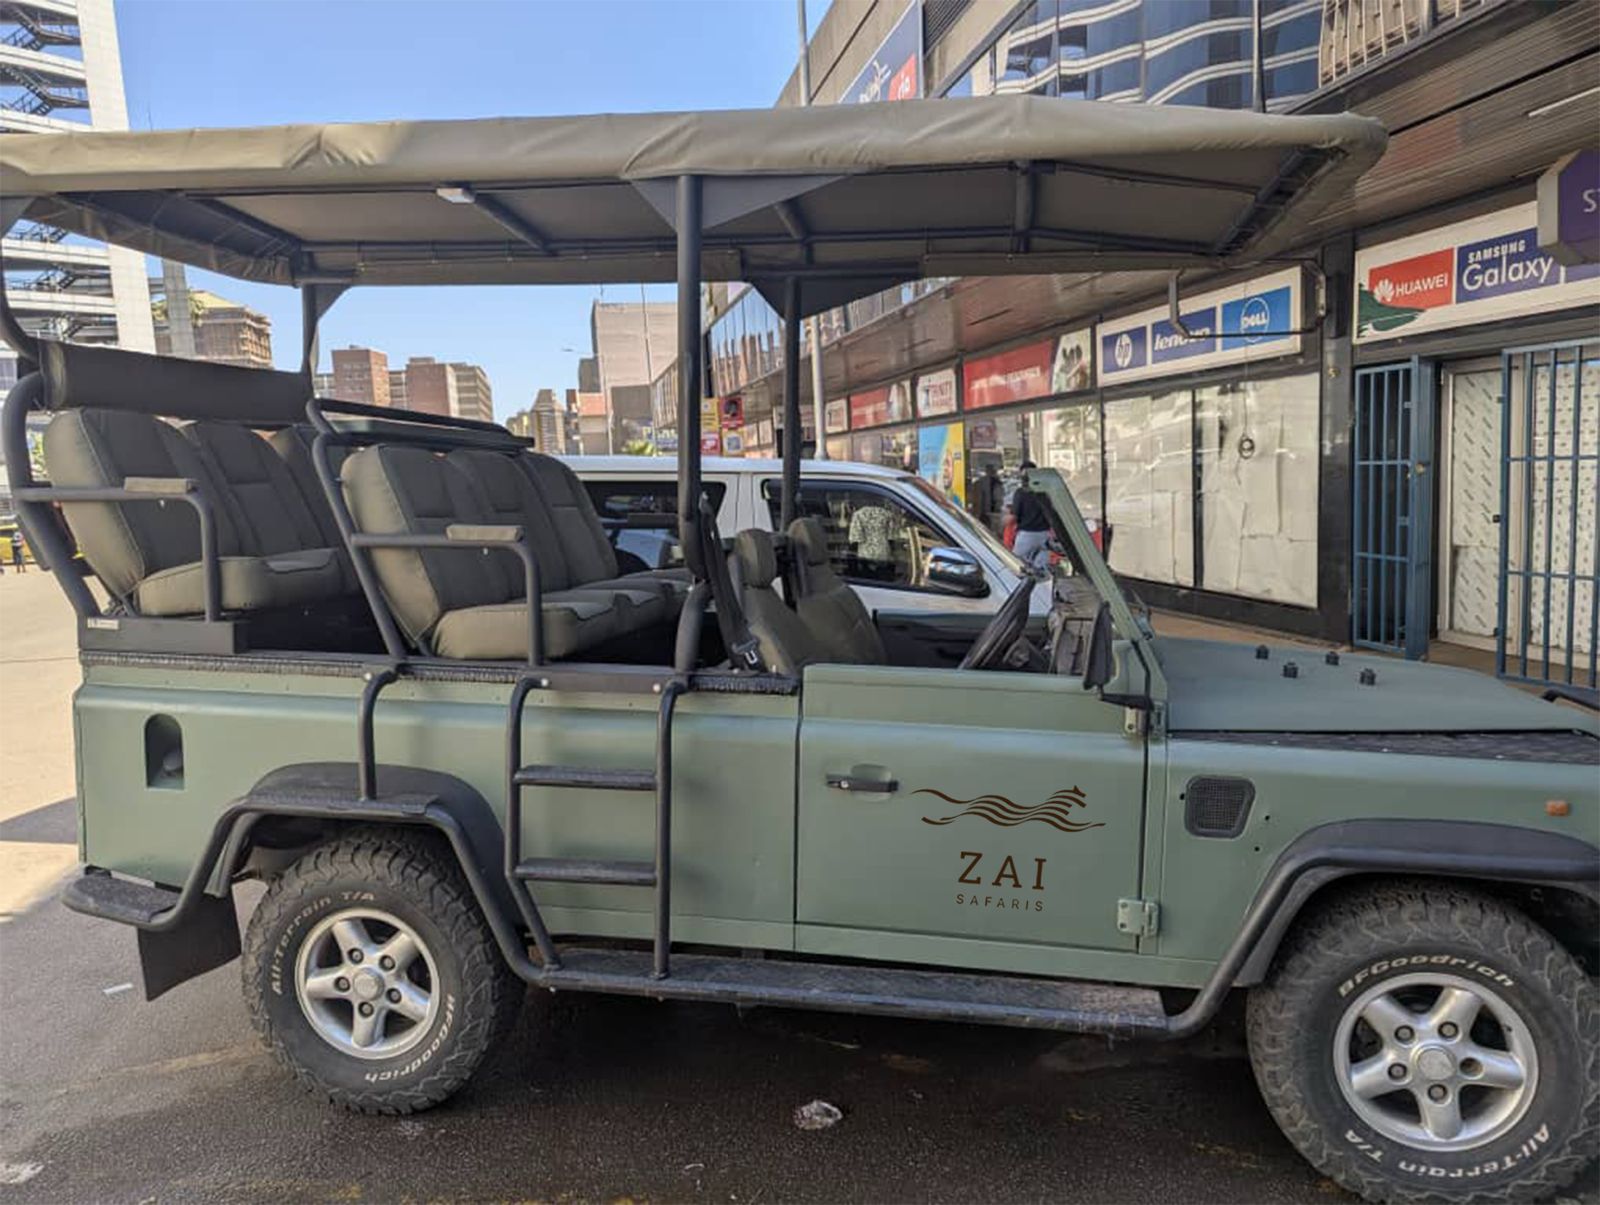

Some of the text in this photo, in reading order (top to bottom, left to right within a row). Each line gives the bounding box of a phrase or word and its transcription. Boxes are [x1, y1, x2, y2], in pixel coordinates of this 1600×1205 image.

[1583, 188, 1600, 212] S
[1468, 240, 1526, 264] SAMSUNG
[1395, 273, 1448, 297] HUAWEI
[1462, 256, 1554, 291] Galaxy
[1116, 334, 1132, 367] hp
[958, 851, 1047, 890] ZAI
[341, 891, 375, 902] T/A
[956, 894, 1044, 912] SAFARIS
[1337, 954, 1514, 998] BFGoodrich
[1344, 1129, 1385, 1163] T/A
